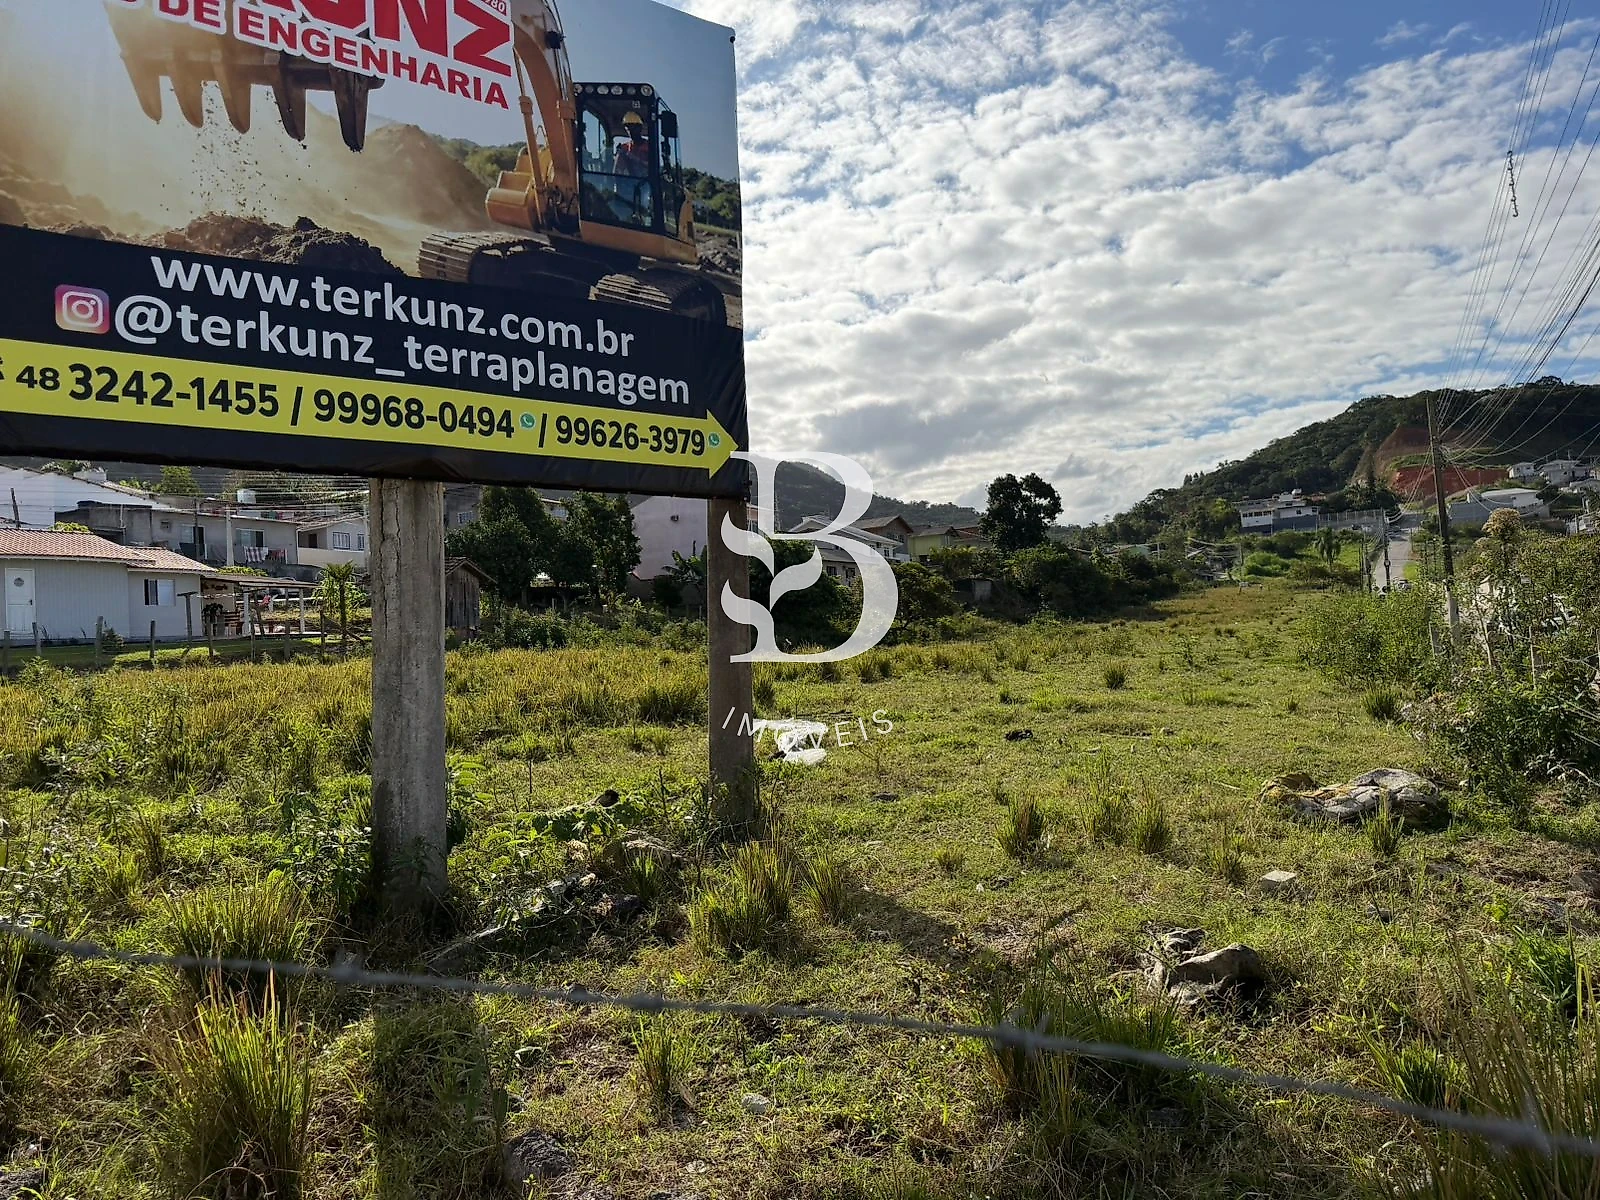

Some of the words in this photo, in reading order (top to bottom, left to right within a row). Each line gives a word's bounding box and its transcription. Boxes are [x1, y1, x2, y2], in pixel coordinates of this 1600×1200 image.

[239, 7, 509, 109] ENGENHARIA
[115, 295, 689, 404] @terkunz_terraplanagem
[150, 256, 635, 357] www.terkunz.com.br
[16, 365, 60, 391] 48
[68, 363, 279, 418] 3242-1455
[313, 388, 515, 438] 99968-0494
[556, 415, 705, 456] 99626-3979
